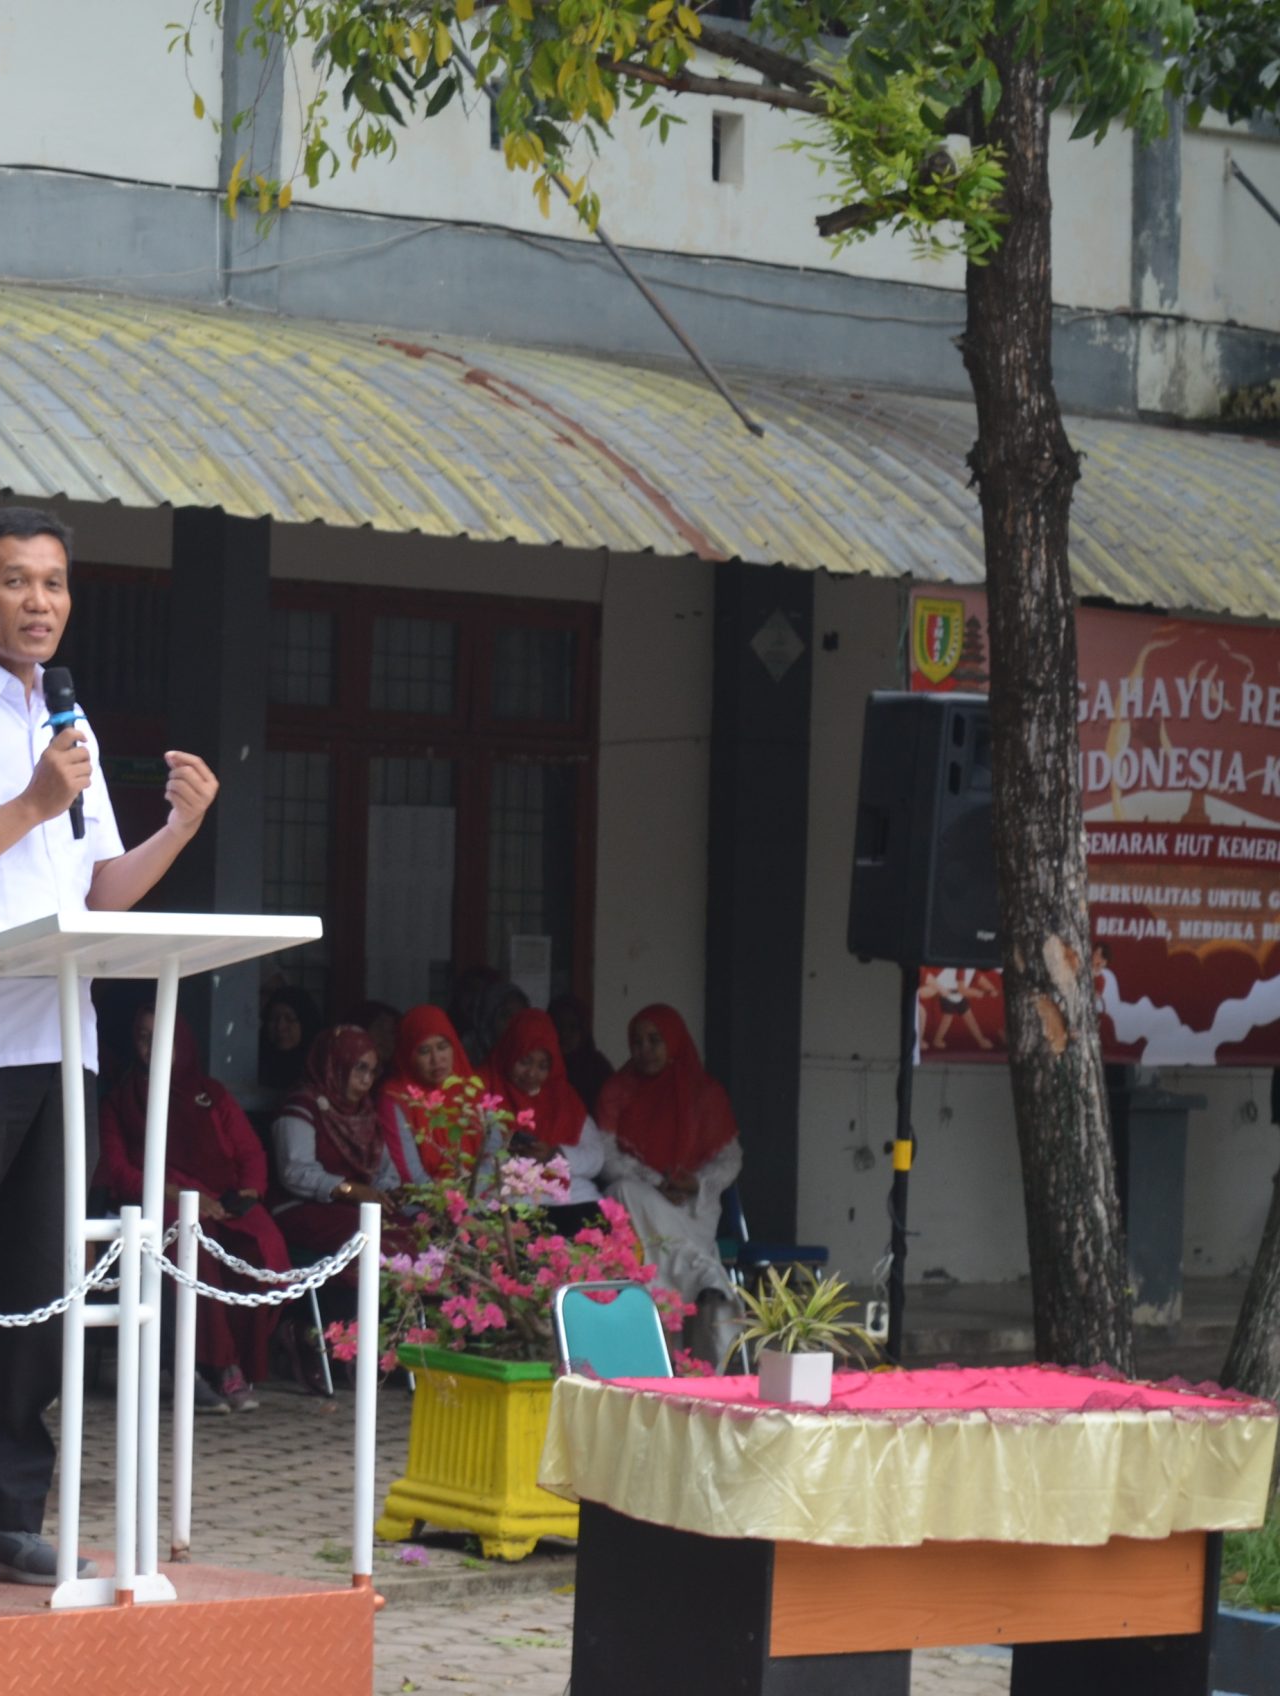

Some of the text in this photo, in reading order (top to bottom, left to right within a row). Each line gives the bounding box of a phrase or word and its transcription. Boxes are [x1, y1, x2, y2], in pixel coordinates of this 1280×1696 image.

[1077, 676, 1280, 728] GAHAYU RE
[1078, 747, 1247, 793] DONESIA
[1174, 834, 1214, 858] HUT
[1088, 883, 1202, 907] BERKUALITAS
[1207, 888, 1262, 910] UNTUK
[1096, 916, 1173, 942] BELAJAR,
[1178, 920, 1255, 941] MERDEKA
